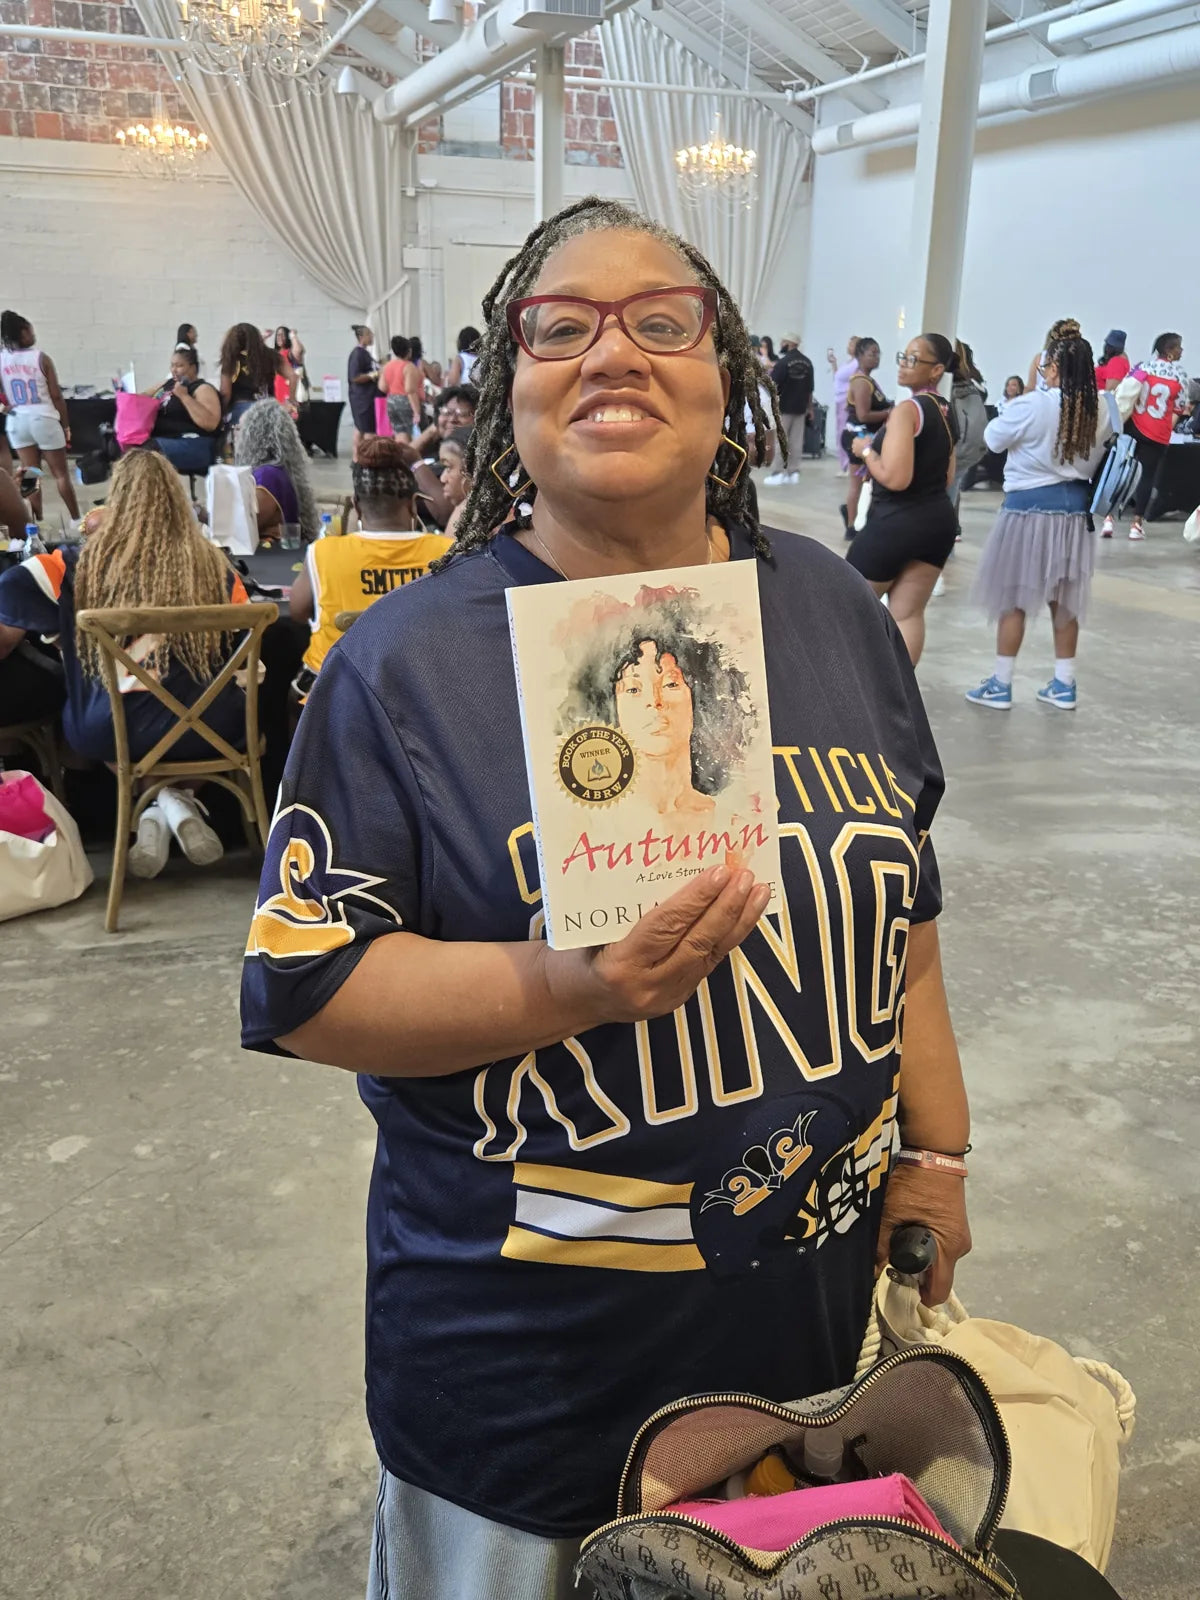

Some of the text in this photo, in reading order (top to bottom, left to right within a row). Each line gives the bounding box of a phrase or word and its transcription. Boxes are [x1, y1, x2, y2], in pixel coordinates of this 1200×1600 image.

[11, 379, 41, 404] 01
[562, 731, 630, 768] BOOK OF THE YEAR
[580, 748, 611, 759] WINNER
[582, 782, 622, 799] ABRW
[562, 823, 769, 875] Autumn
[635, 873, 646, 883] A
[647, 871, 673, 882] Love
[564, 903, 660, 932] NORI
